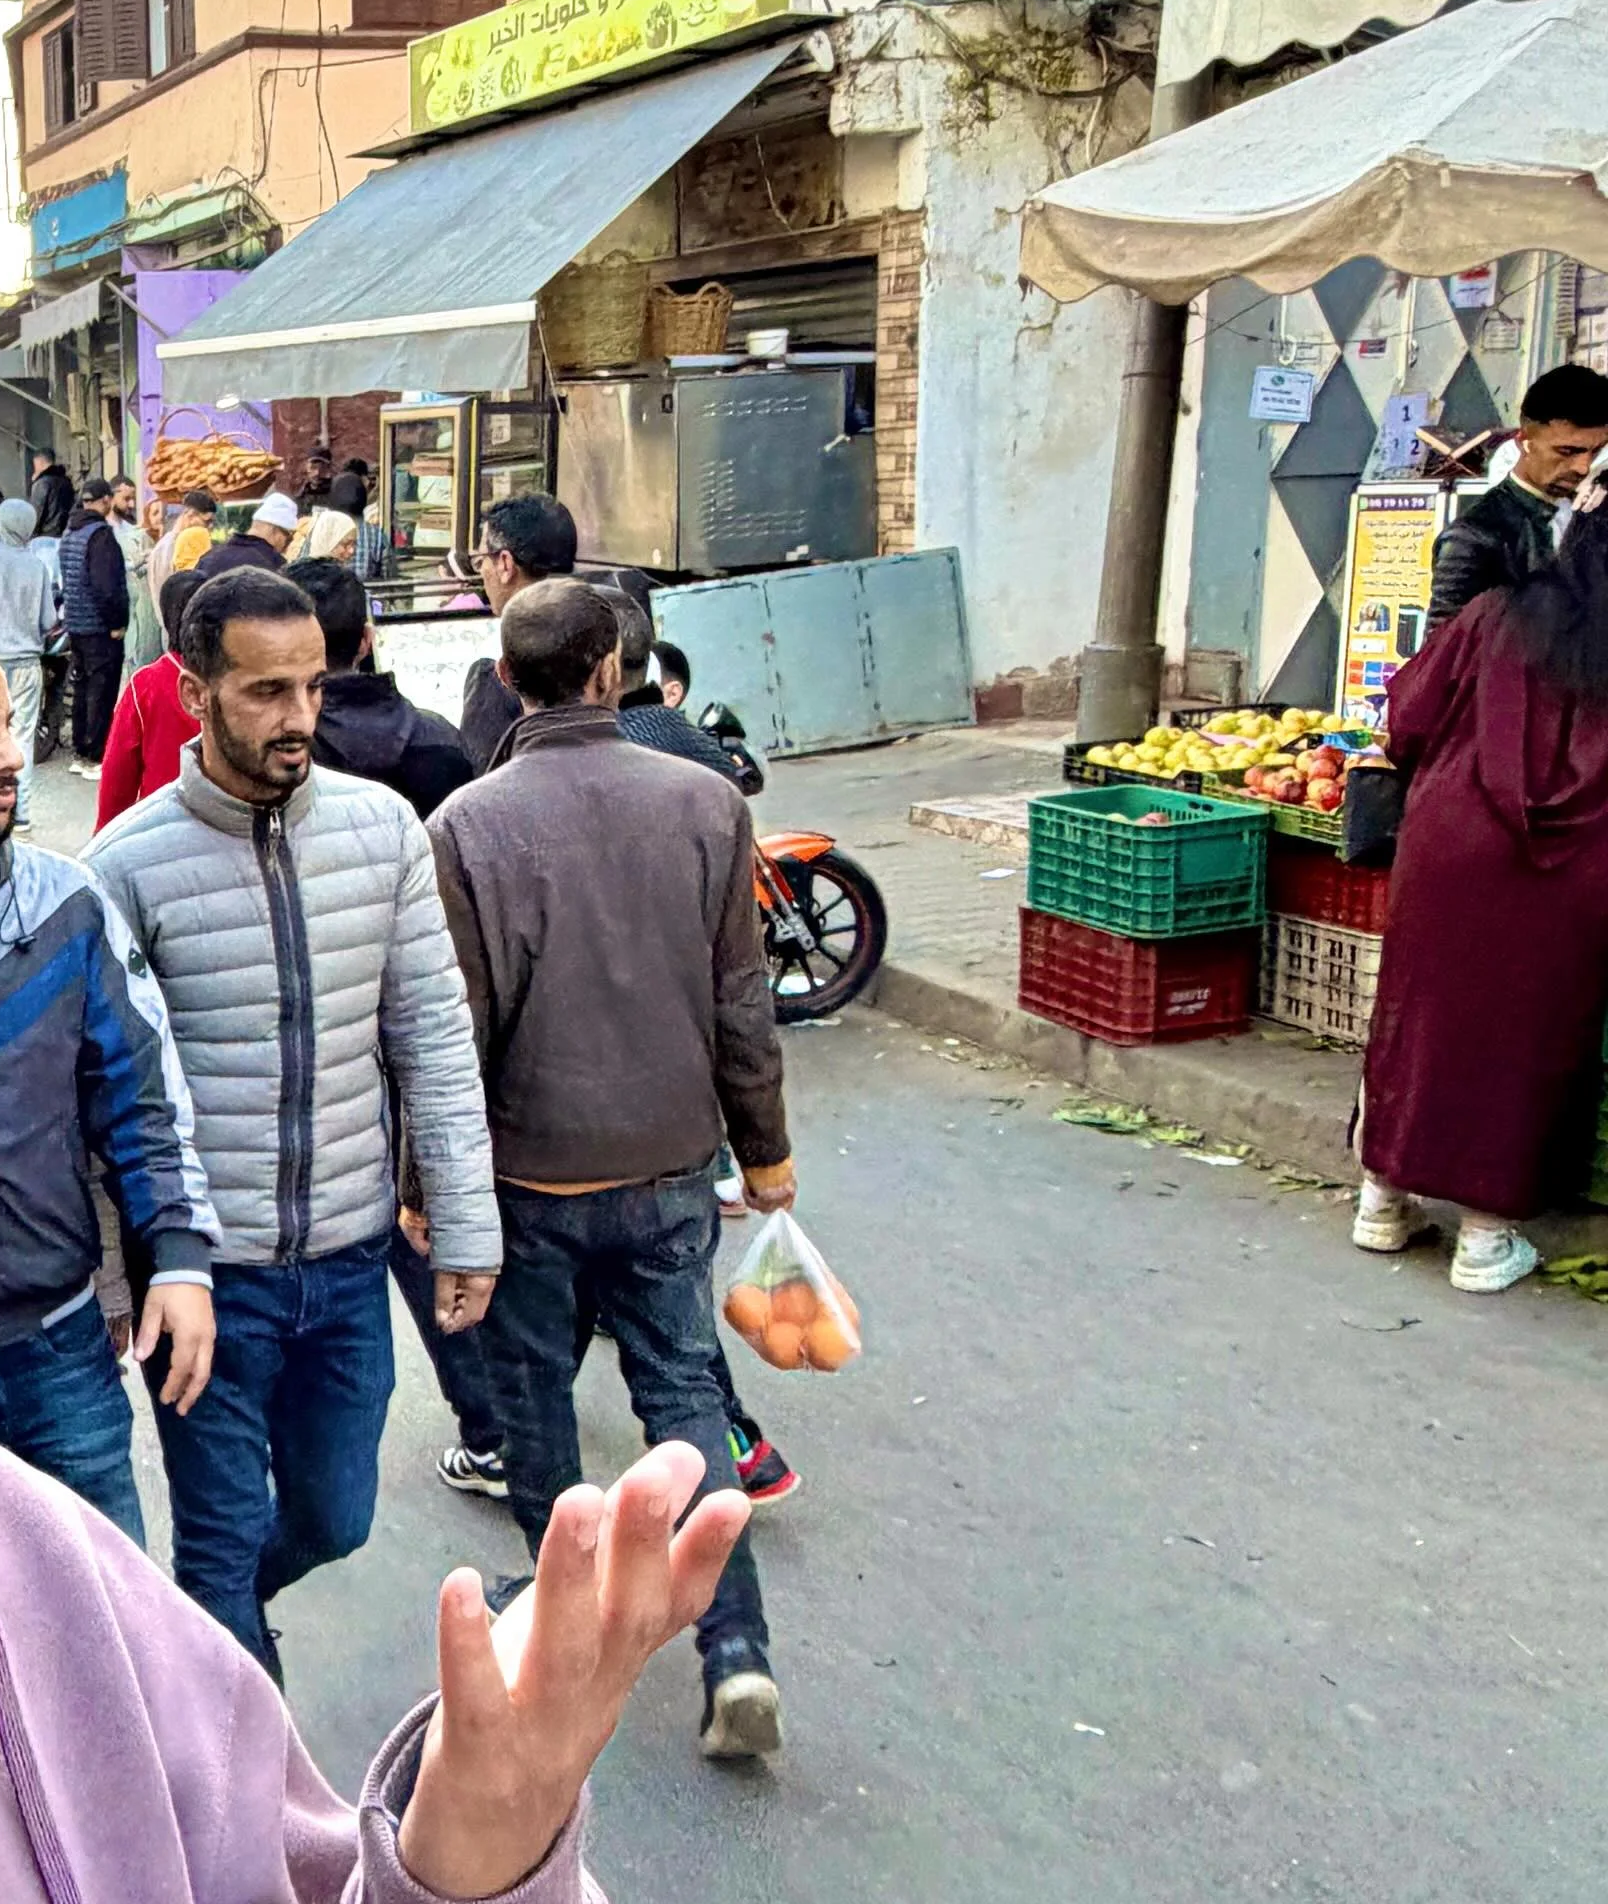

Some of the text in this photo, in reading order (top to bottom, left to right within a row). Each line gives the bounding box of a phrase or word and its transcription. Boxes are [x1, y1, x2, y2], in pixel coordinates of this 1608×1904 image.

[487, 12, 525, 56] الخير
[1402, 404, 1411, 422] 1
[1410, 439, 1420, 456] 2
